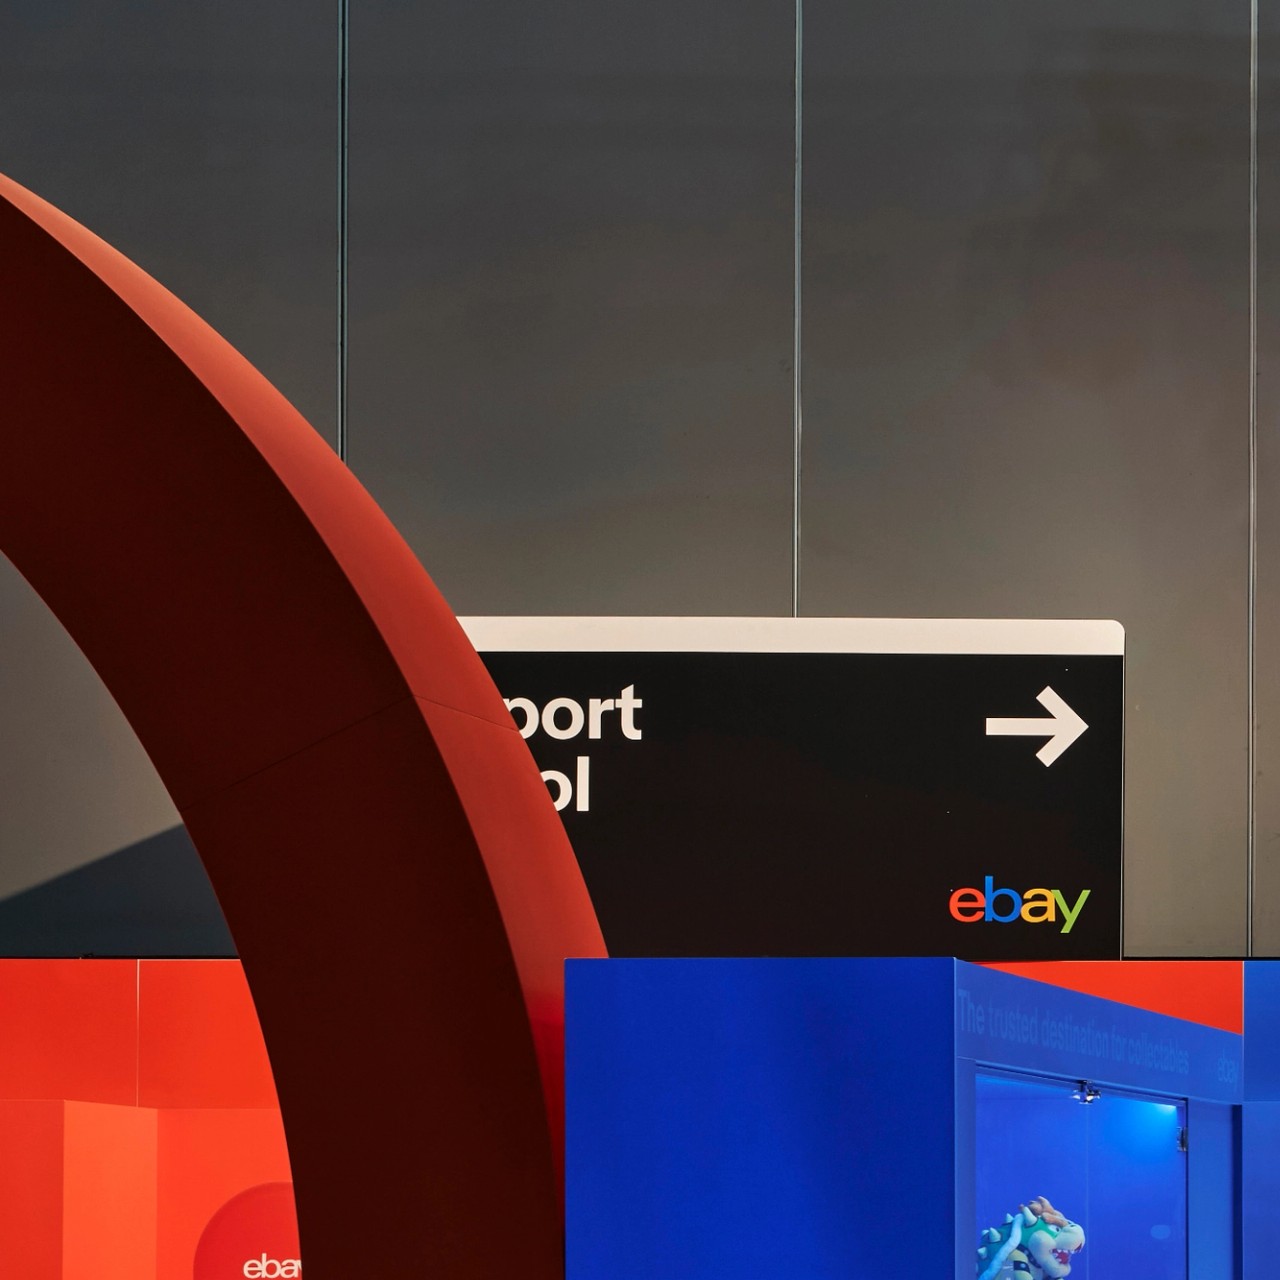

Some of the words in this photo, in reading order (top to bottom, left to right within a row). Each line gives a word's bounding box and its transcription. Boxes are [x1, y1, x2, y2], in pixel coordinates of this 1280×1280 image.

[949, 875, 1091, 933] ebay
[957, 989, 985, 1034] The
[988, 1006, 1038, 1045] trusted
[1041, 1011, 1110, 1058] destination
[1111, 1025, 1126, 1062] for
[1128, 1032, 1190, 1075] collectables
